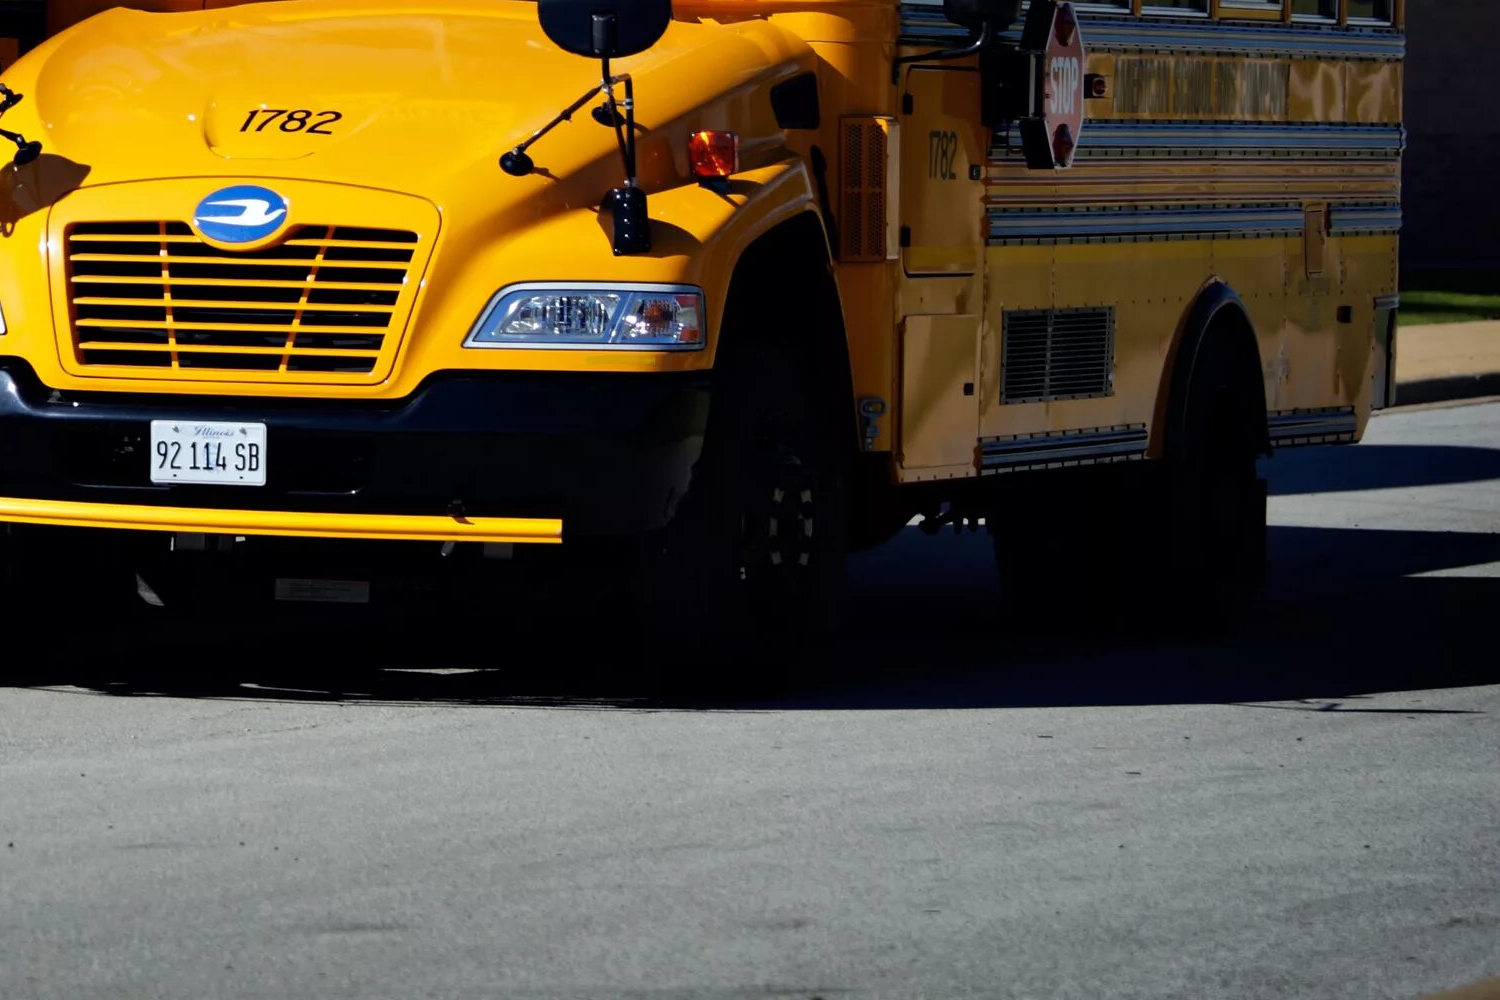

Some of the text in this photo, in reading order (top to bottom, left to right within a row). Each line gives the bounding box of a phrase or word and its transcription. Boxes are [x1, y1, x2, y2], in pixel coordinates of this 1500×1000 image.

[1049, 56, 1078, 115] STOP
[239, 108, 343, 135] 1782
[929, 130, 957, 180] 1782
[193, 426, 234, 437] Illinois
[156, 440, 260, 472] 92 114 SB
